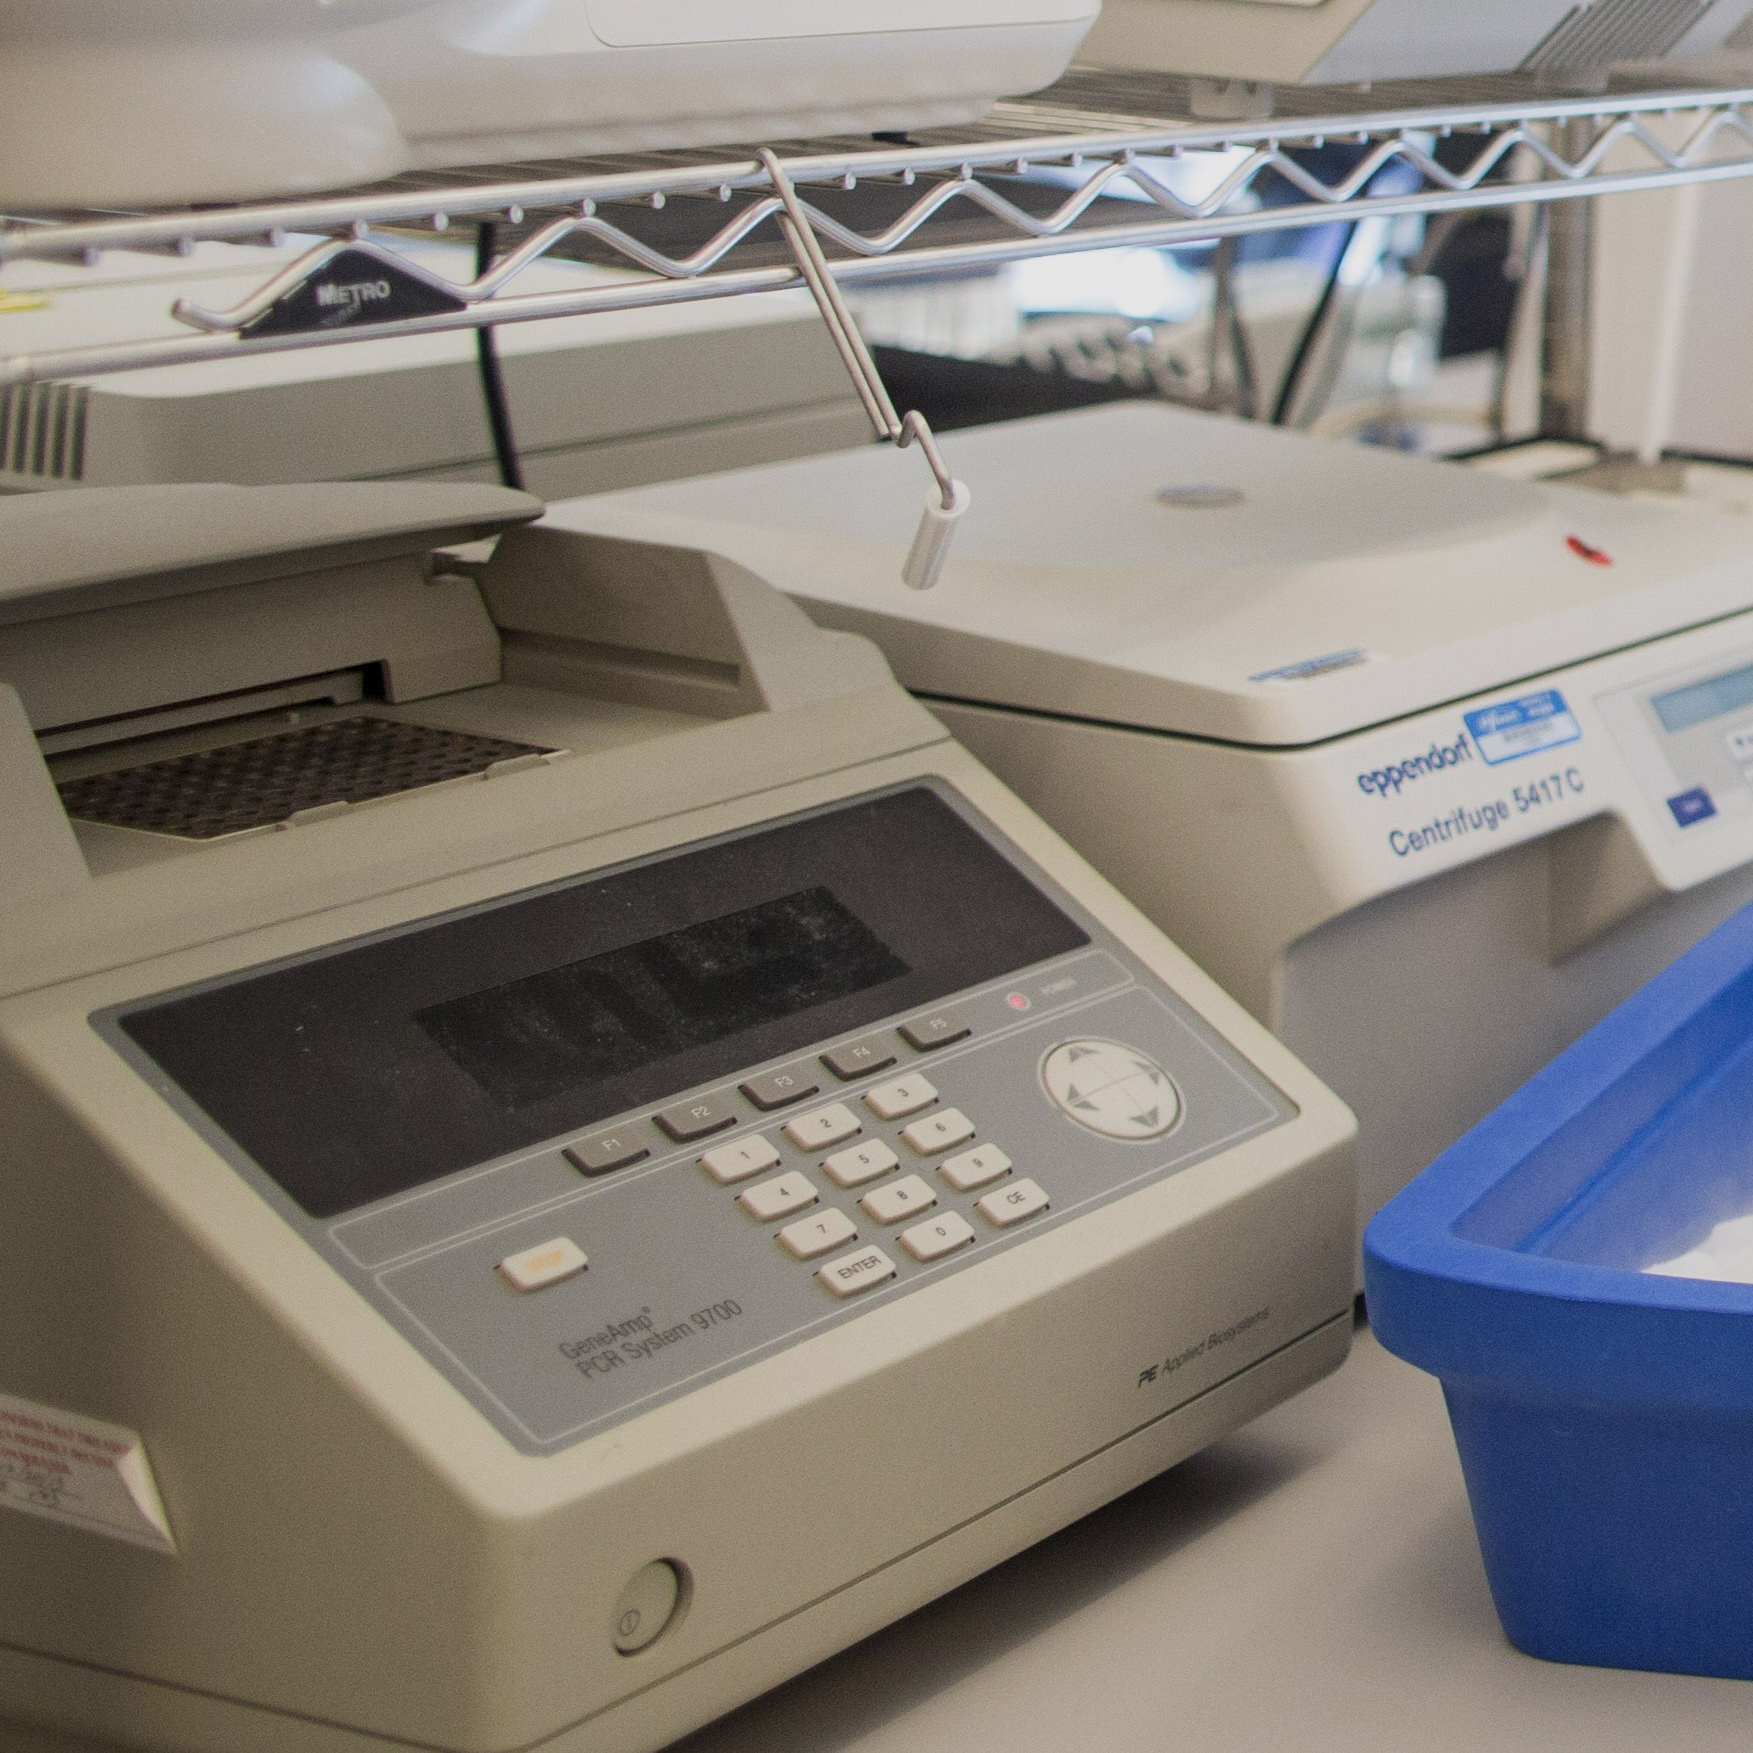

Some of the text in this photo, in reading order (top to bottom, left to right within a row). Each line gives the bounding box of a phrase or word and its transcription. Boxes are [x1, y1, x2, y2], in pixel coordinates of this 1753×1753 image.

[1389, 799, 1509, 857] Centrifuge
[852, 1045, 872, 1059] F4
[774, 1074, 794, 1089] F3
[690, 1105, 712, 1119] F2
[819, 1117, 832, 1129] 2
[601, 1137, 622, 1152] F1
[858, 1153, 871, 1165] 5
[779, 1186, 791, 1198] 4
[1006, 1190, 1026, 1206] CE
[816, 1223, 828, 1235] 7
[837, 1255, 883, 1280] ENTER
[575, 1299, 743, 1379] PCR System 9700
